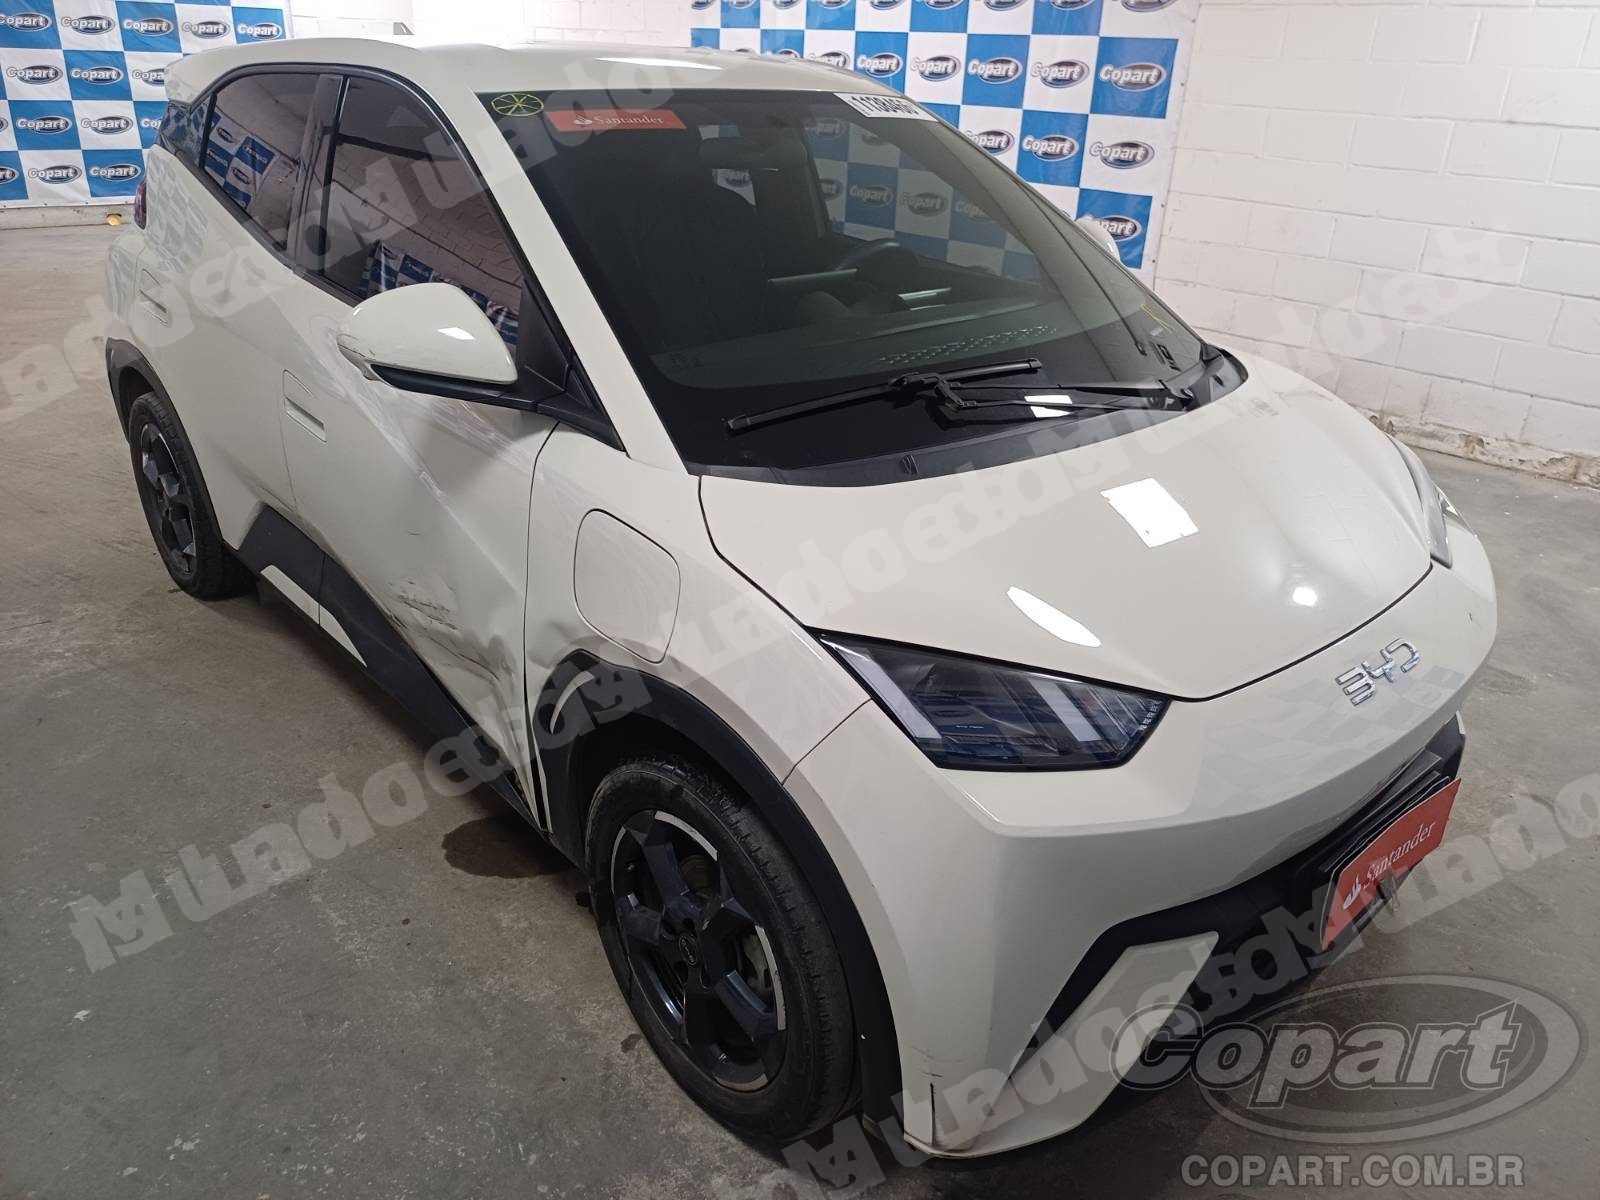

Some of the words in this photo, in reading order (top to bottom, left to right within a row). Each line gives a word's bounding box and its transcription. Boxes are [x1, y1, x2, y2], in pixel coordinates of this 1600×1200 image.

[61, 17, 109, 30] Copart
[123, 19, 168, 33] Copart
[182, 21, 225, 34] Copart
[236, 23, 278, 37] Copart
[856, 54, 897, 71] Copart
[911, 57, 956, 75] Copart
[968, 58, 1015, 79] Copart
[6, 66, 57, 80] Copart
[71, 67, 118, 80] Copart
[1031, 61, 1081, 81] Copart
[1100, 63, 1159, 86] Copart
[17, 118, 67, 131] Copart
[81, 118, 129, 132] Copart
[593, 114, 664, 126] Santander
[1022, 134, 1071, 155] Copart
[1090, 141, 1144, 162] Copart
[27, 166, 76, 181] Copart
[90, 166, 137, 178] Copart
[1362, 820, 1437, 890] Santander
